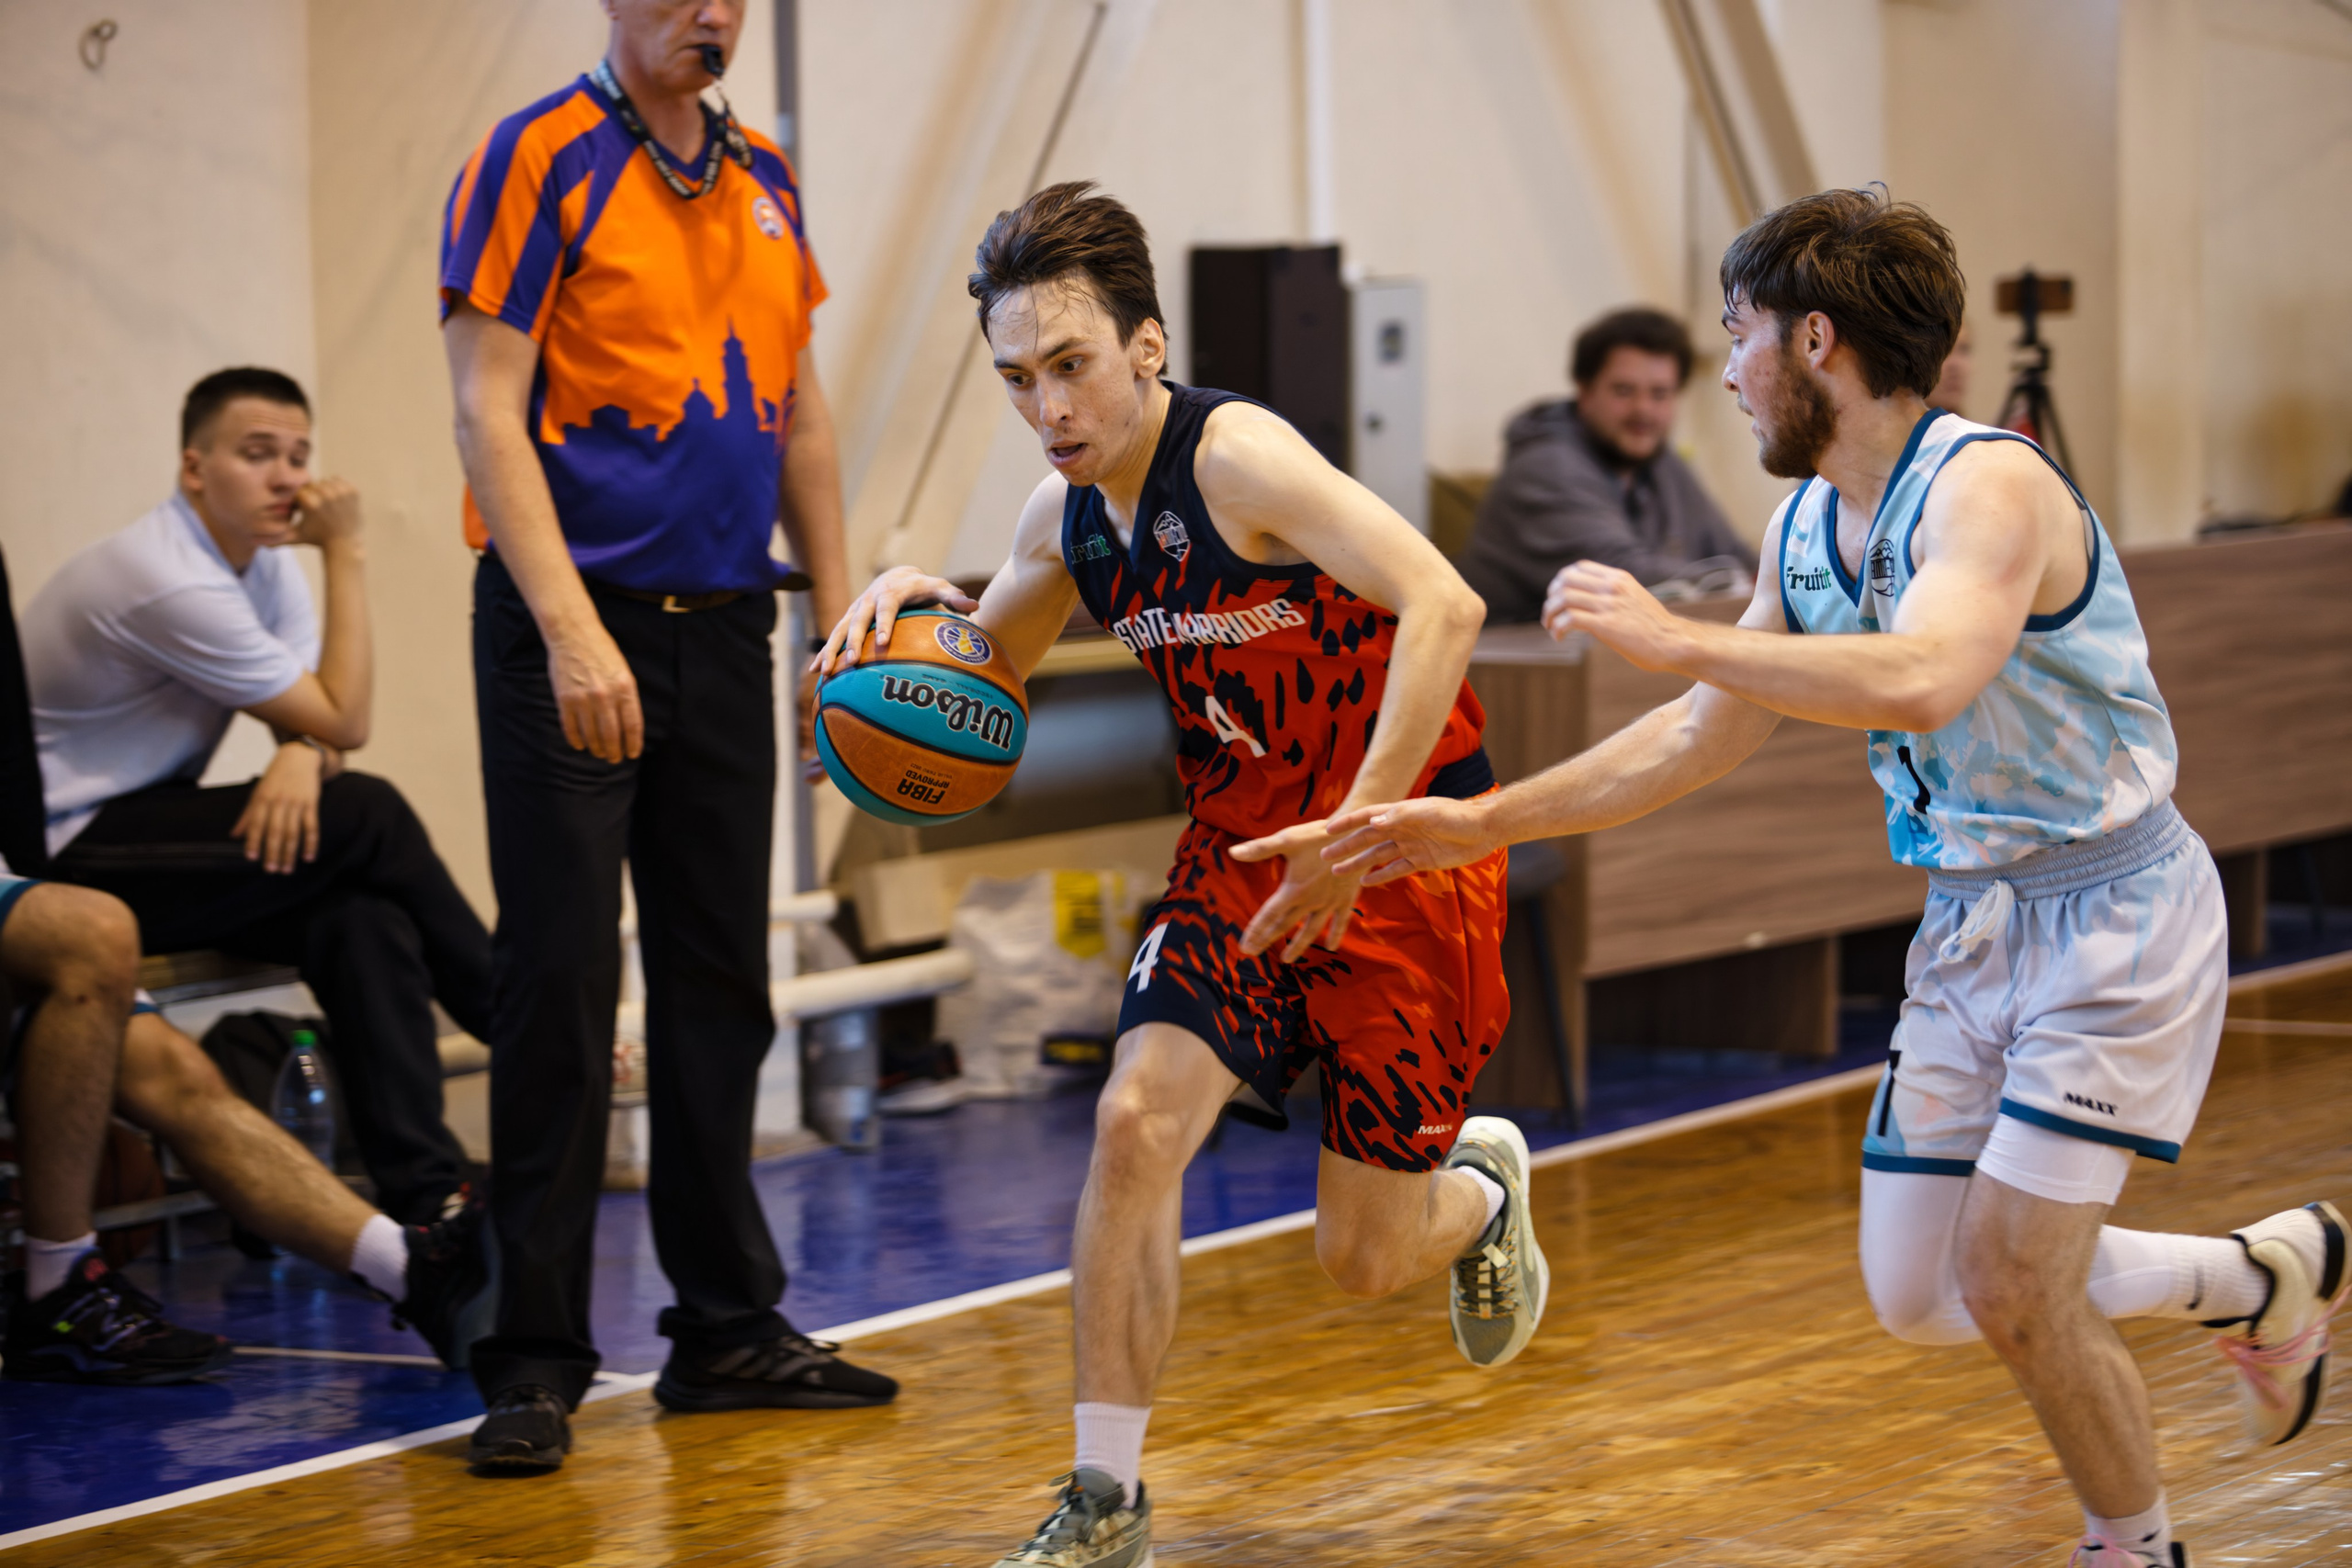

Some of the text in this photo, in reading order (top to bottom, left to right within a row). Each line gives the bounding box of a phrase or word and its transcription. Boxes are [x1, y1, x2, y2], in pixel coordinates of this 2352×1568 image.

[1113, 607, 1178, 653] STATE
[883, 675, 1013, 751] Wilson
[1205, 695, 1266, 758] 4
[897, 779, 945, 805] FIBA
[906, 770, 950, 788] APPROVED
[1127, 922, 1169, 993] 4
